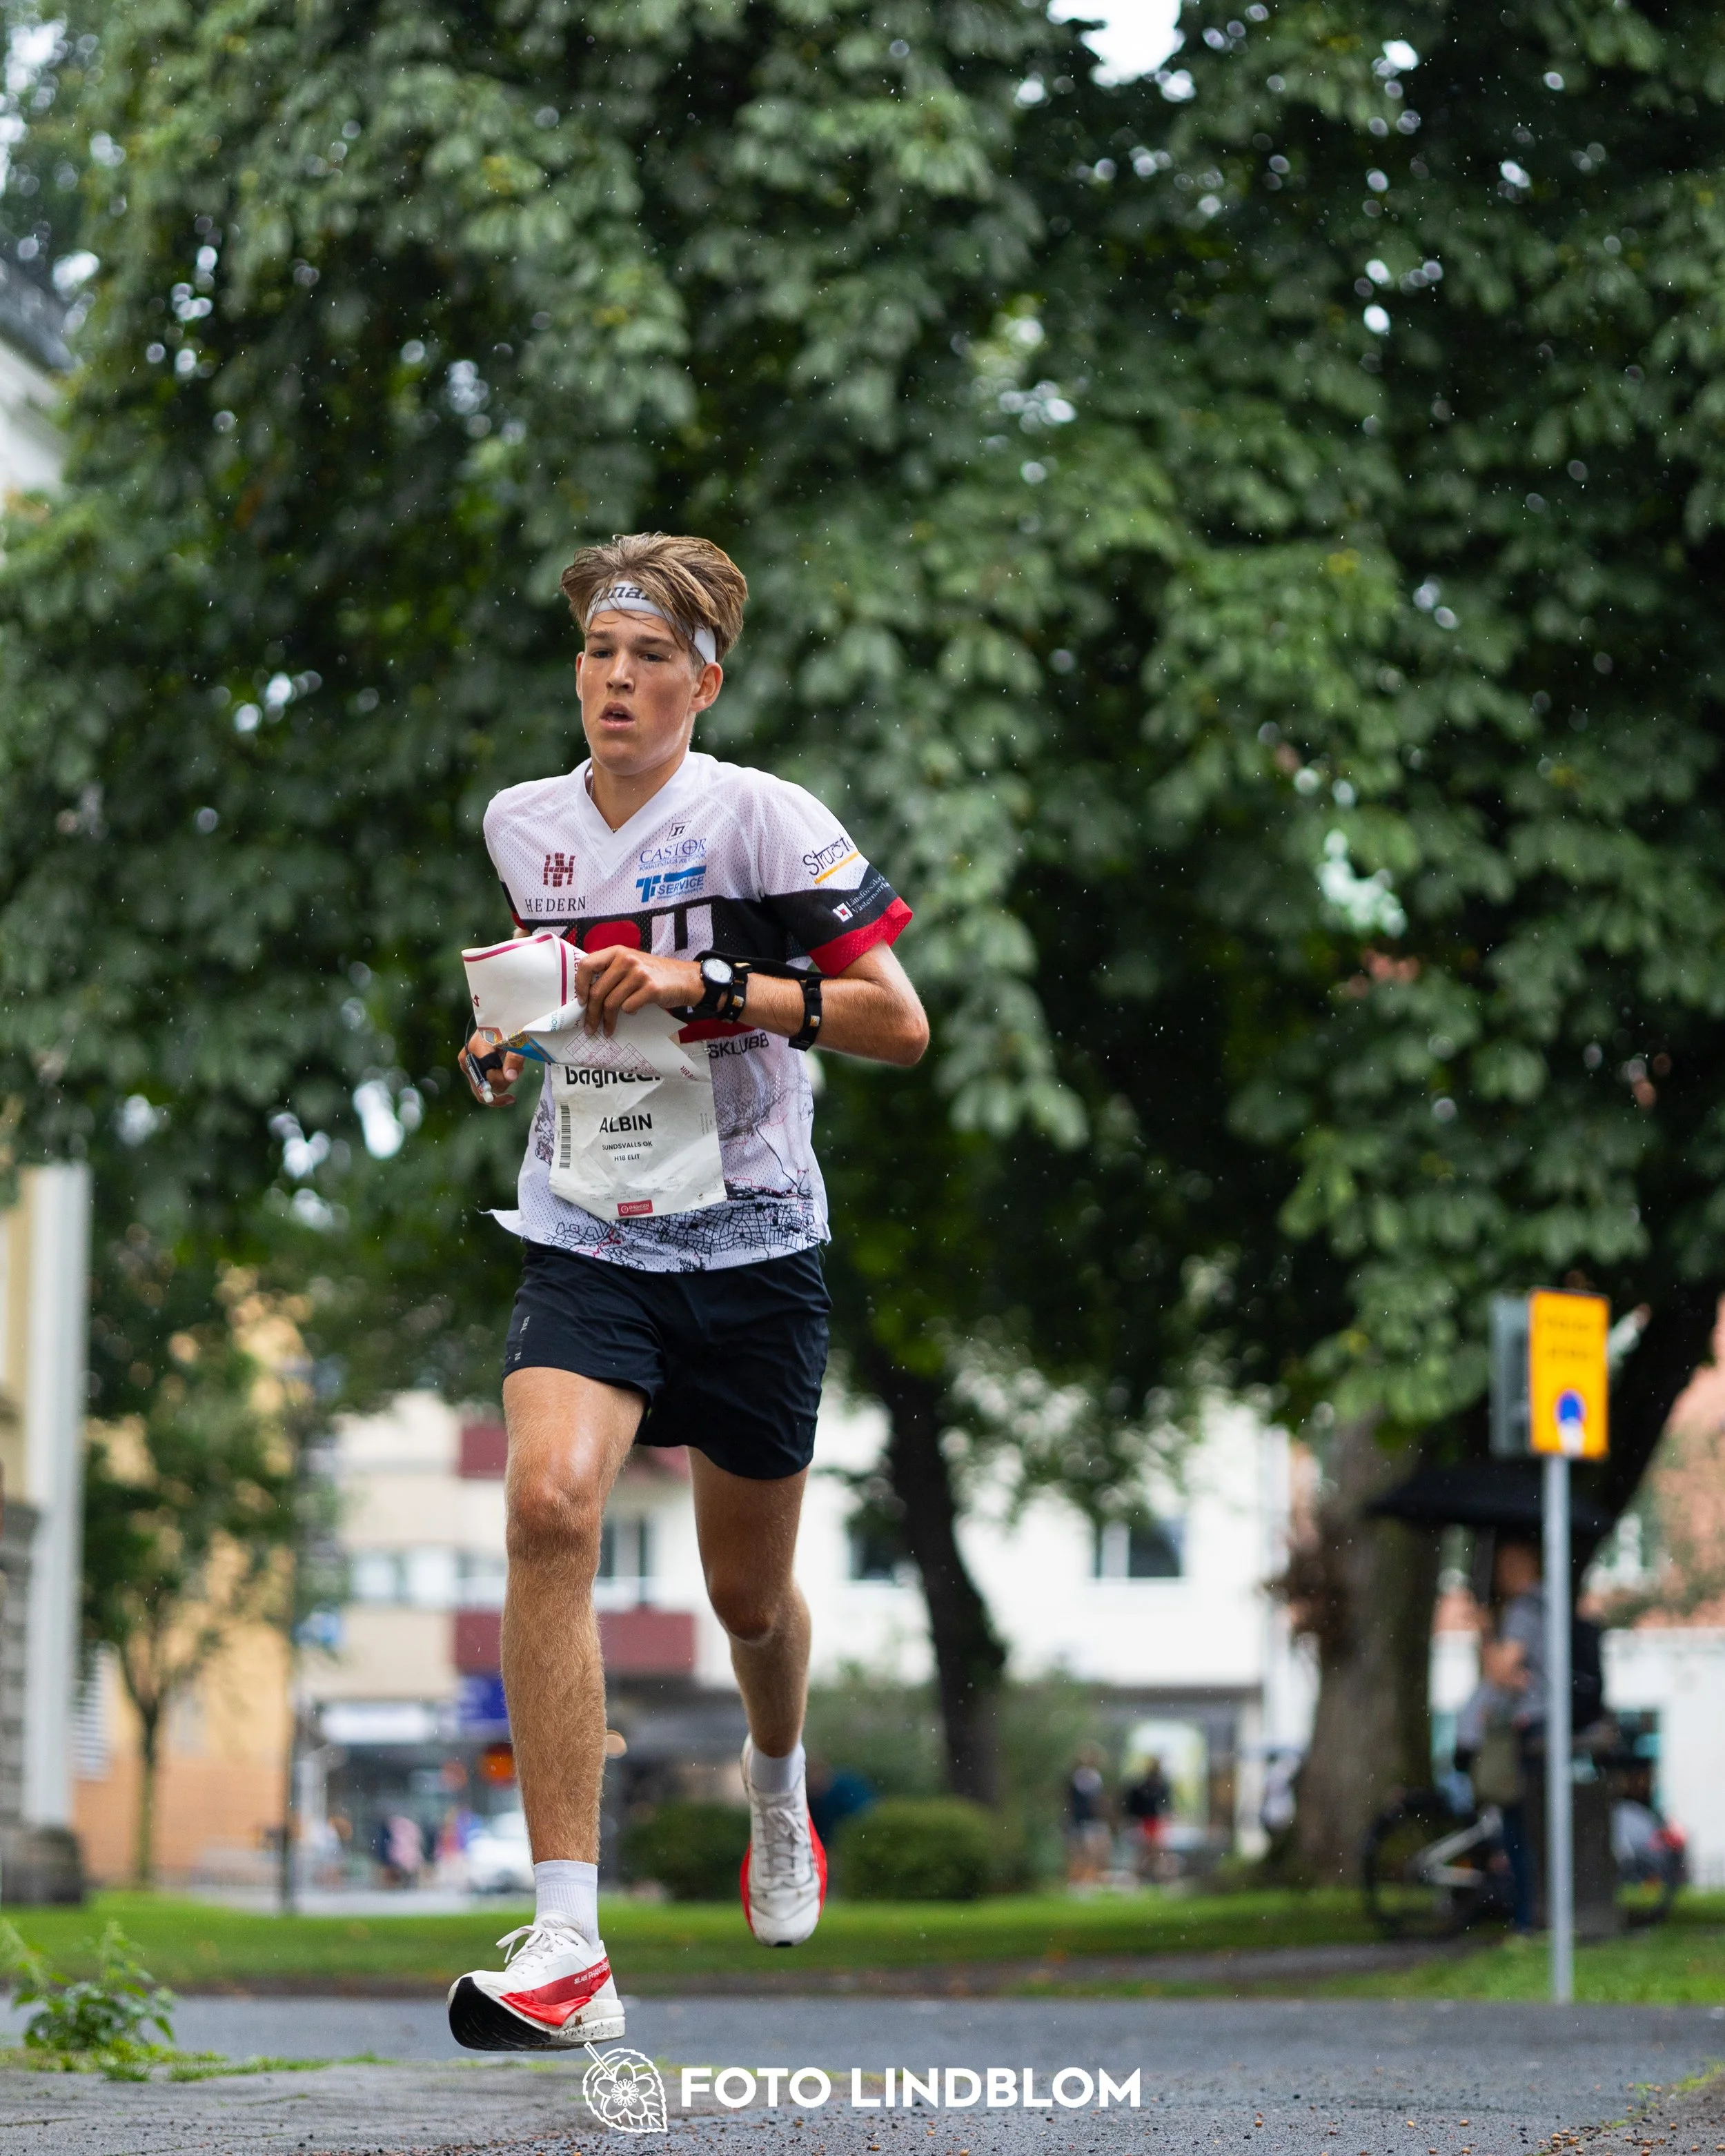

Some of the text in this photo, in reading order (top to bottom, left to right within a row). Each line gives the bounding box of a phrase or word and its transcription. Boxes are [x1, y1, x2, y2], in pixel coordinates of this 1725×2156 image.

[640, 838, 707, 864] CASTOR
[657, 875, 704, 895] SERVICE
[524, 896, 586, 912] HEDERN
[707, 1032, 769, 1058] SKLUBB
[599, 1113, 653, 1133] ALBIN
[602, 1141, 642, 1151] SUNDSVALLS
